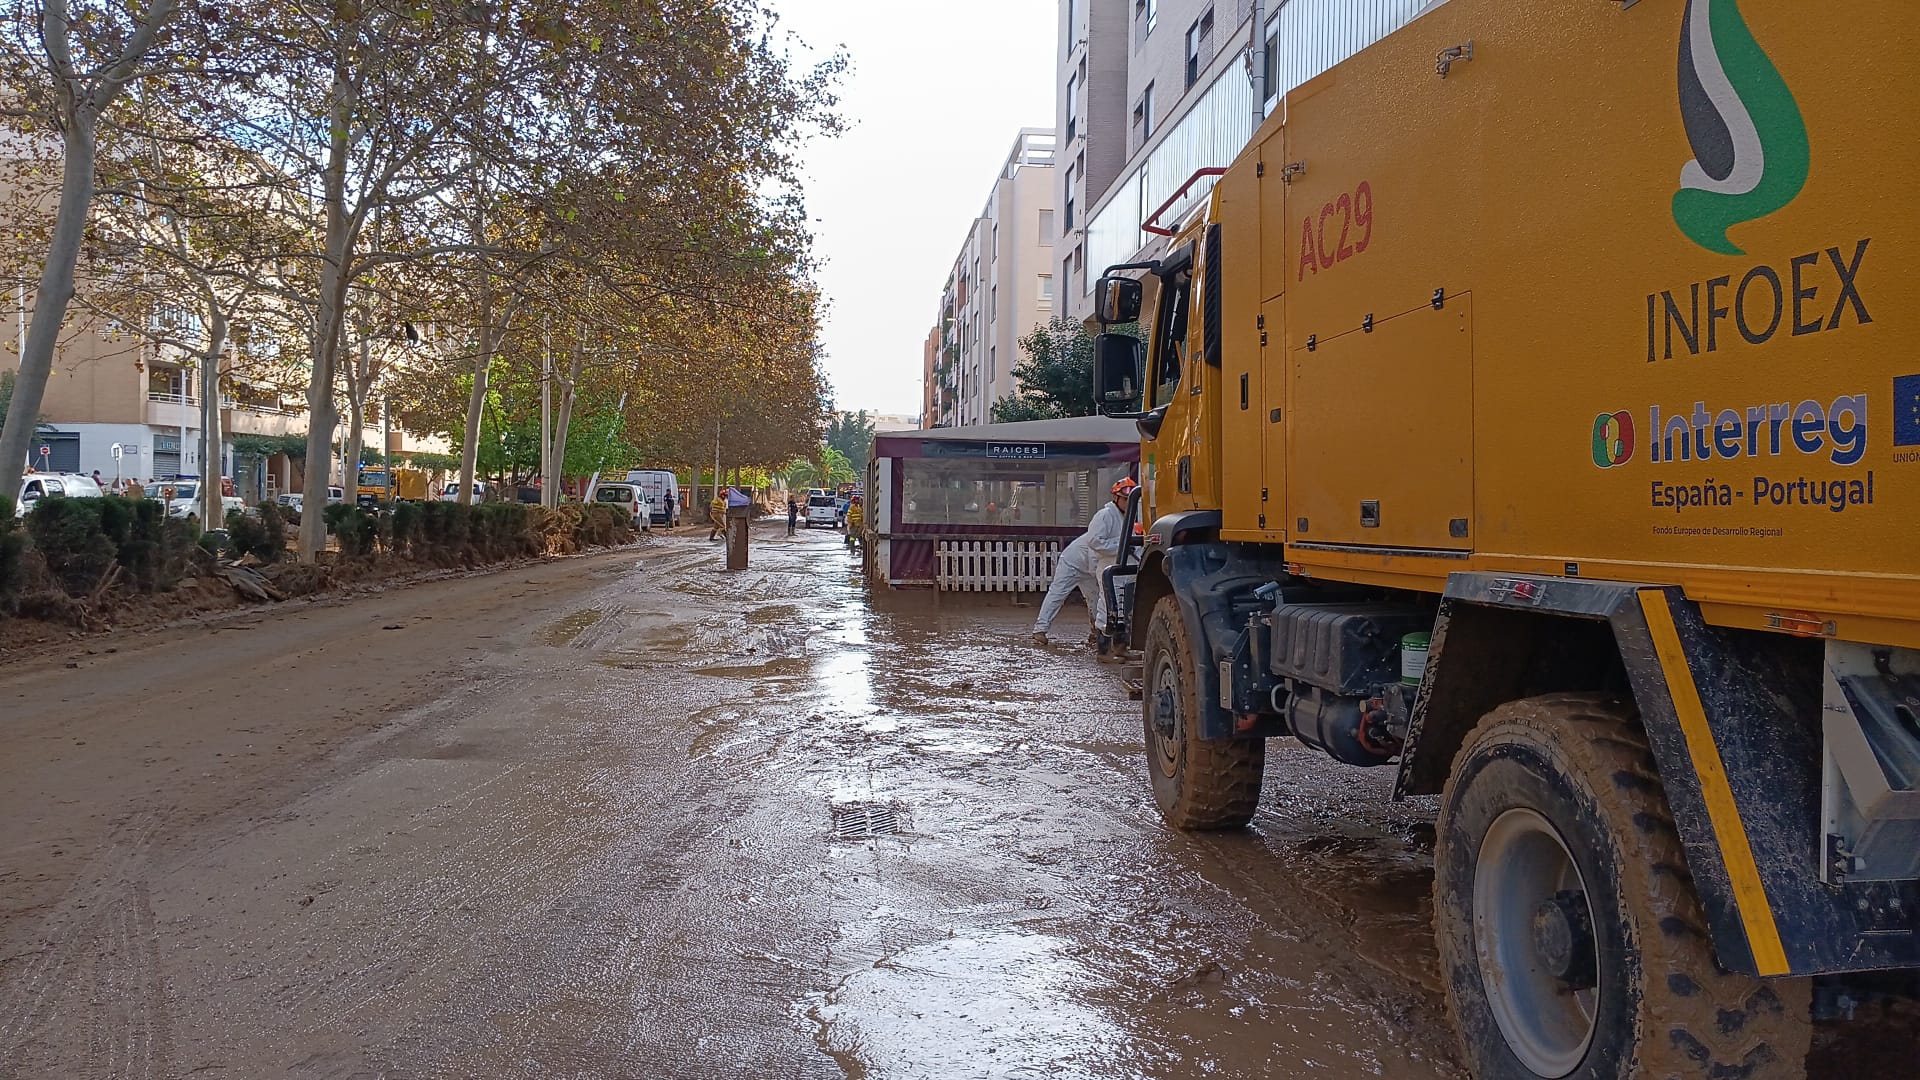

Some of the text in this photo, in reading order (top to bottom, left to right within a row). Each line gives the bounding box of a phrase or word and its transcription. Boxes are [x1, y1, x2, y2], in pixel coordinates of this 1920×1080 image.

[1298, 180, 1372, 282] AC29
[1646, 237, 1873, 363] INFOEX
[993, 446, 1039, 454] RAICES
[1650, 393, 1867, 467] Interreg
[1753, 470, 1874, 513] Portugal
[1653, 525, 1783, 538] Fondo Europeo de Desarrollo Regional
